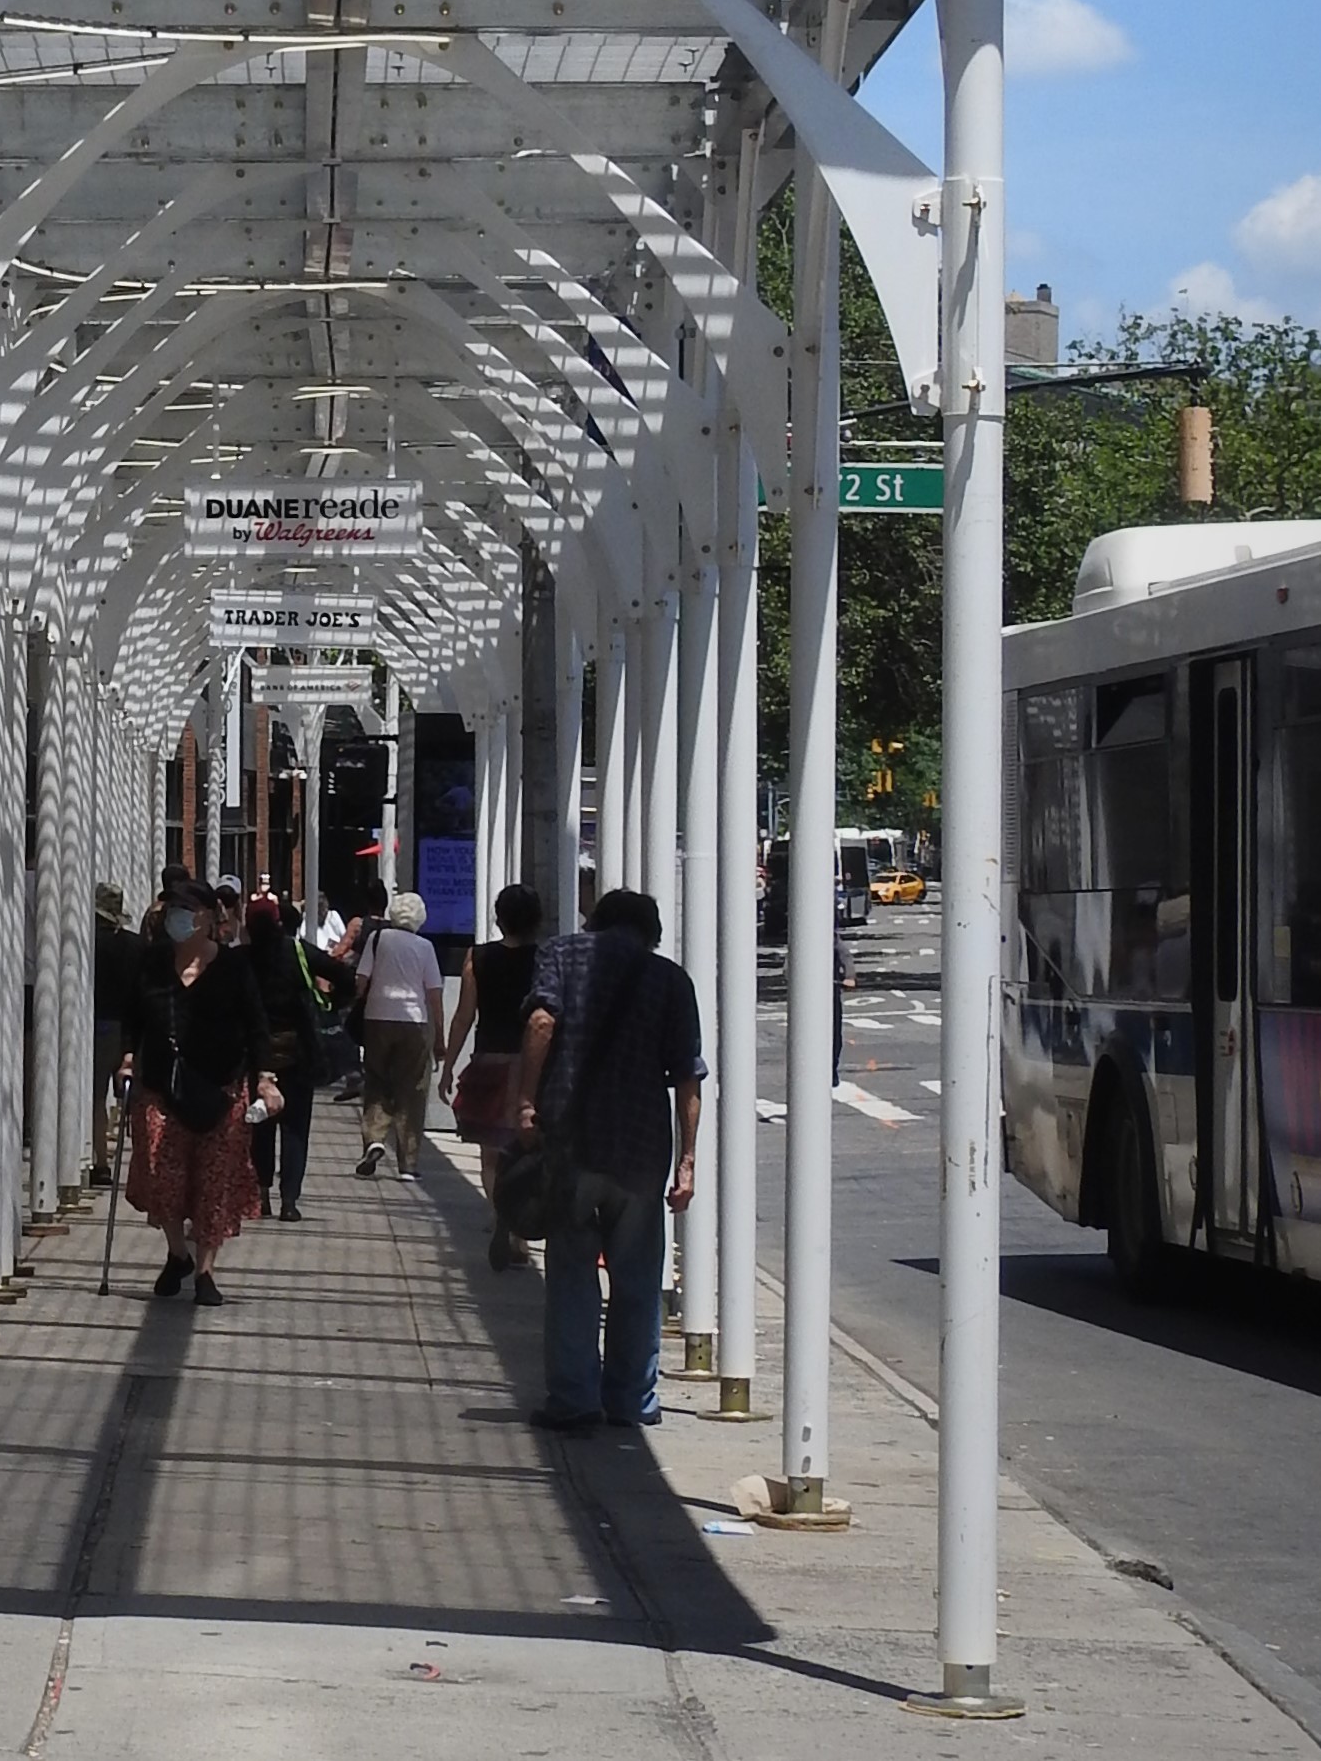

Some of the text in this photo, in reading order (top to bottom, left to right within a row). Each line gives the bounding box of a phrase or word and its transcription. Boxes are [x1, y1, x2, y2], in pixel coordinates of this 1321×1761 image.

[838, 474, 905, 501] 2 St
[232, 521, 376, 548] by Walgreens
[224, 609, 362, 628] TRADER JOE'S
[260, 684, 342, 692] BANK OF AMERICA
